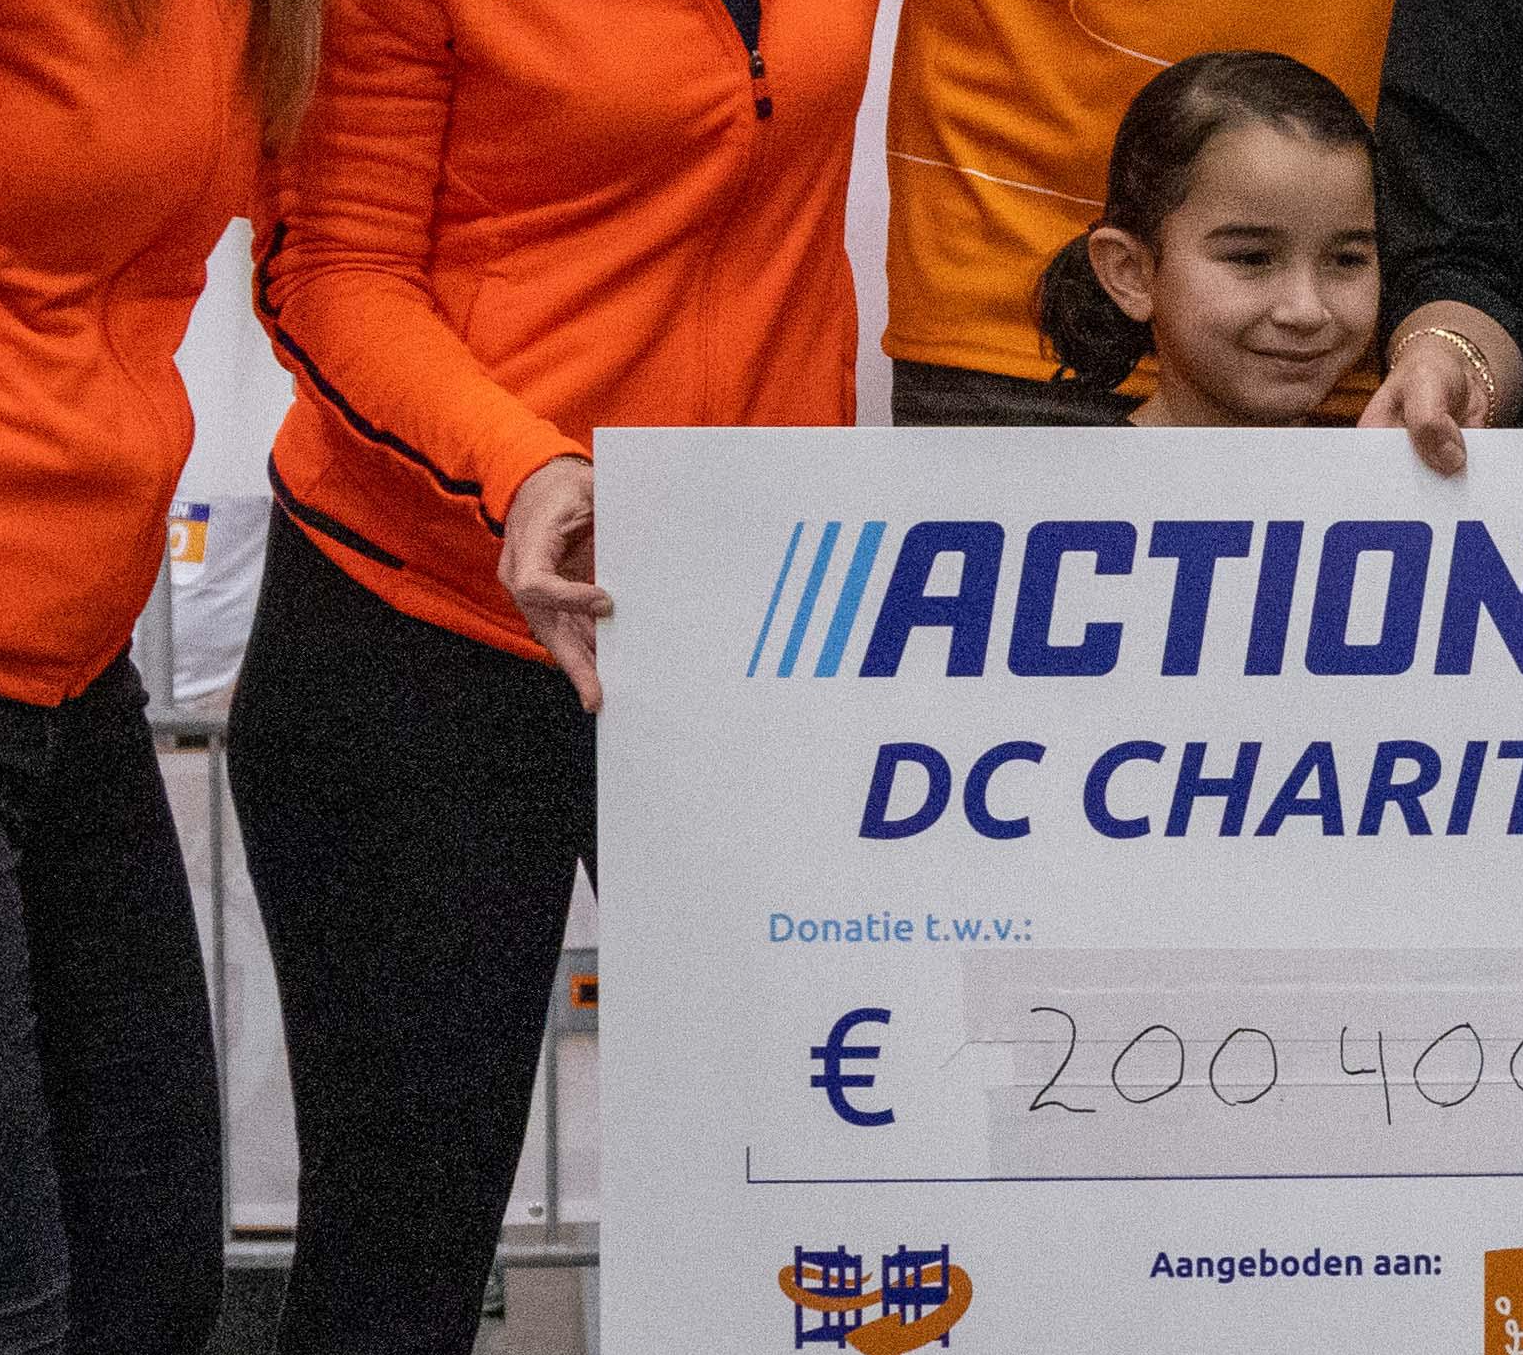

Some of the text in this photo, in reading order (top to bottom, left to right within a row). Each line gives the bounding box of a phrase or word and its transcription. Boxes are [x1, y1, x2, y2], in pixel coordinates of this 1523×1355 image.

[858, 739, 1048, 841] DC
[769, 911, 1032, 943] Donatie t.w.v.:
[810, 1007, 896, 1127] €
[1149, 1247, 1443, 1284] Aangeboden aan:
